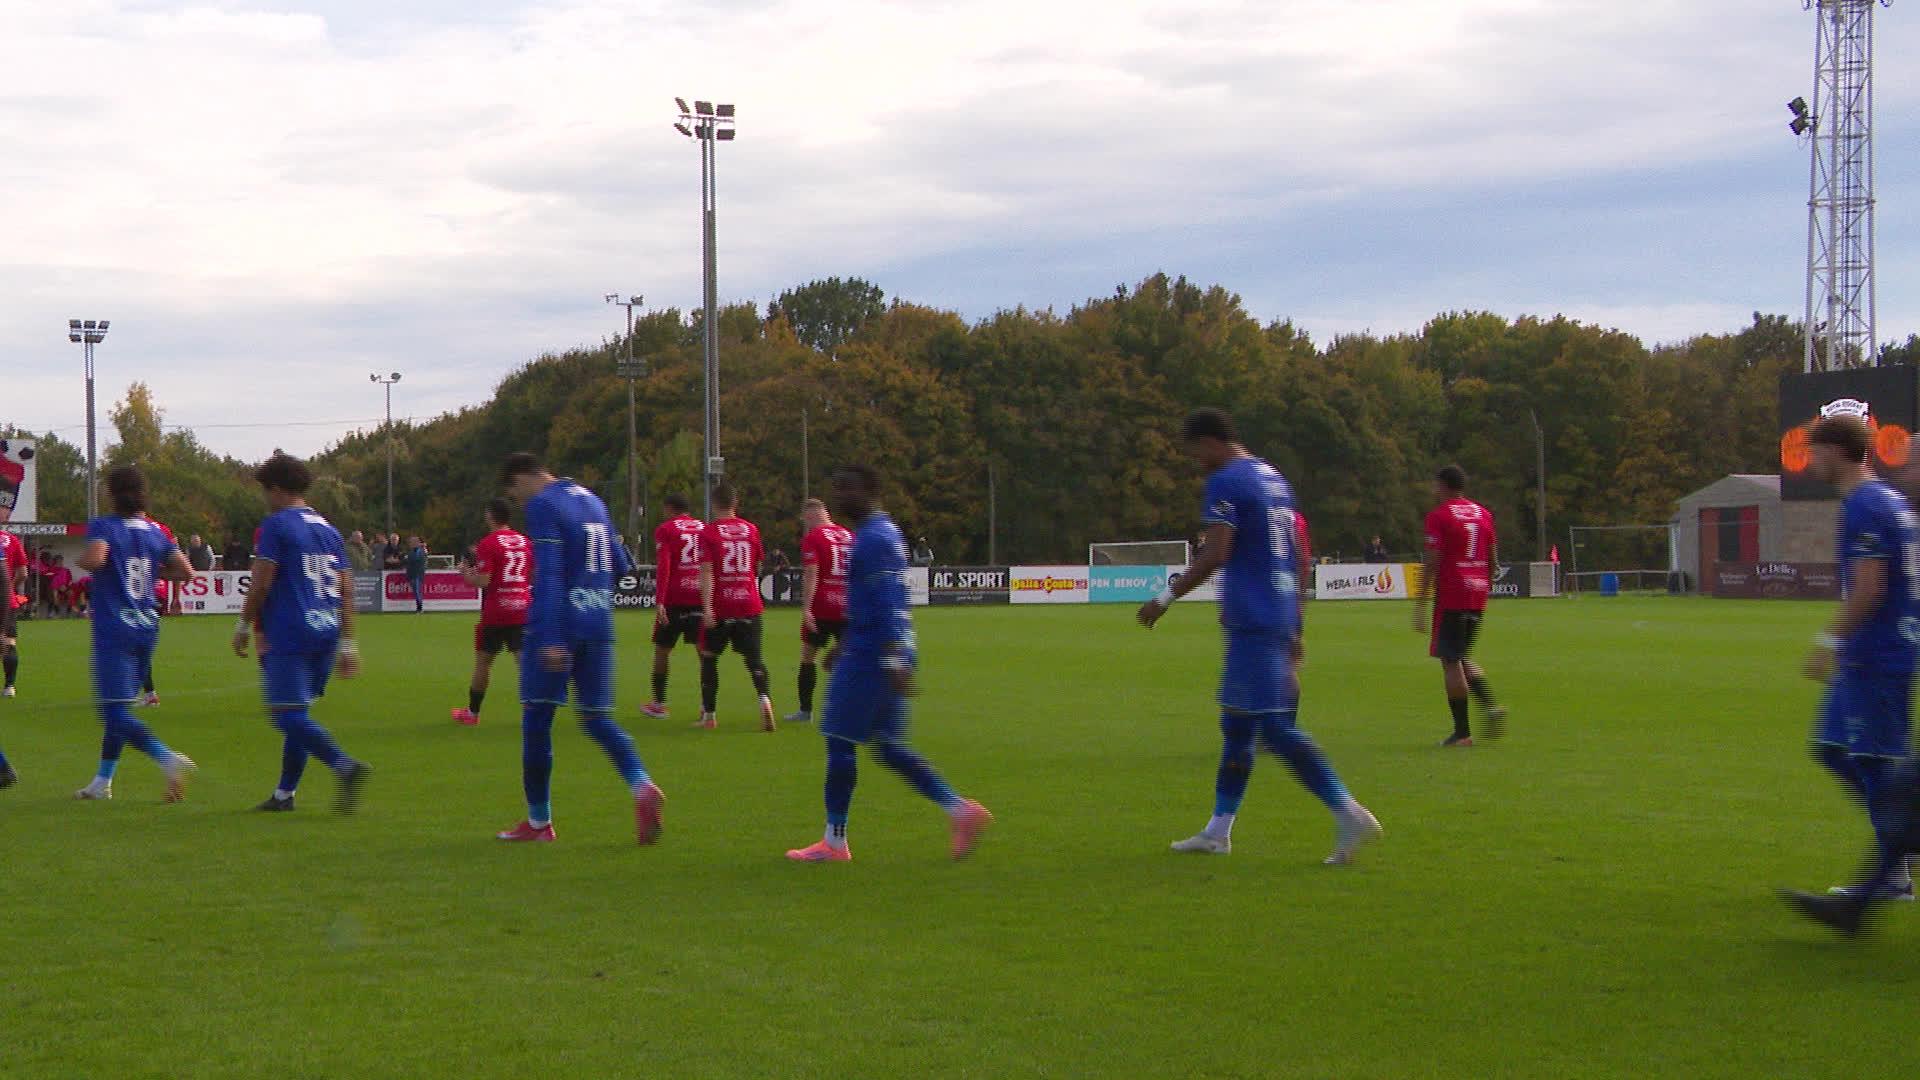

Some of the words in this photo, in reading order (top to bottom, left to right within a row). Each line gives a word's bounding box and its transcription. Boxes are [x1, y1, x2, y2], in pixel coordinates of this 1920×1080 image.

[582, 523, 614, 574] 11
[721, 541, 751, 574] 20
[302, 555, 342, 600] 45
[502, 551, 527, 583] 22
[933, 572, 953, 588] AC
[957, 572, 1005, 588] SPORT
[1326, 578, 1351, 590] WERA
[1358, 575, 1375, 587] FILS
